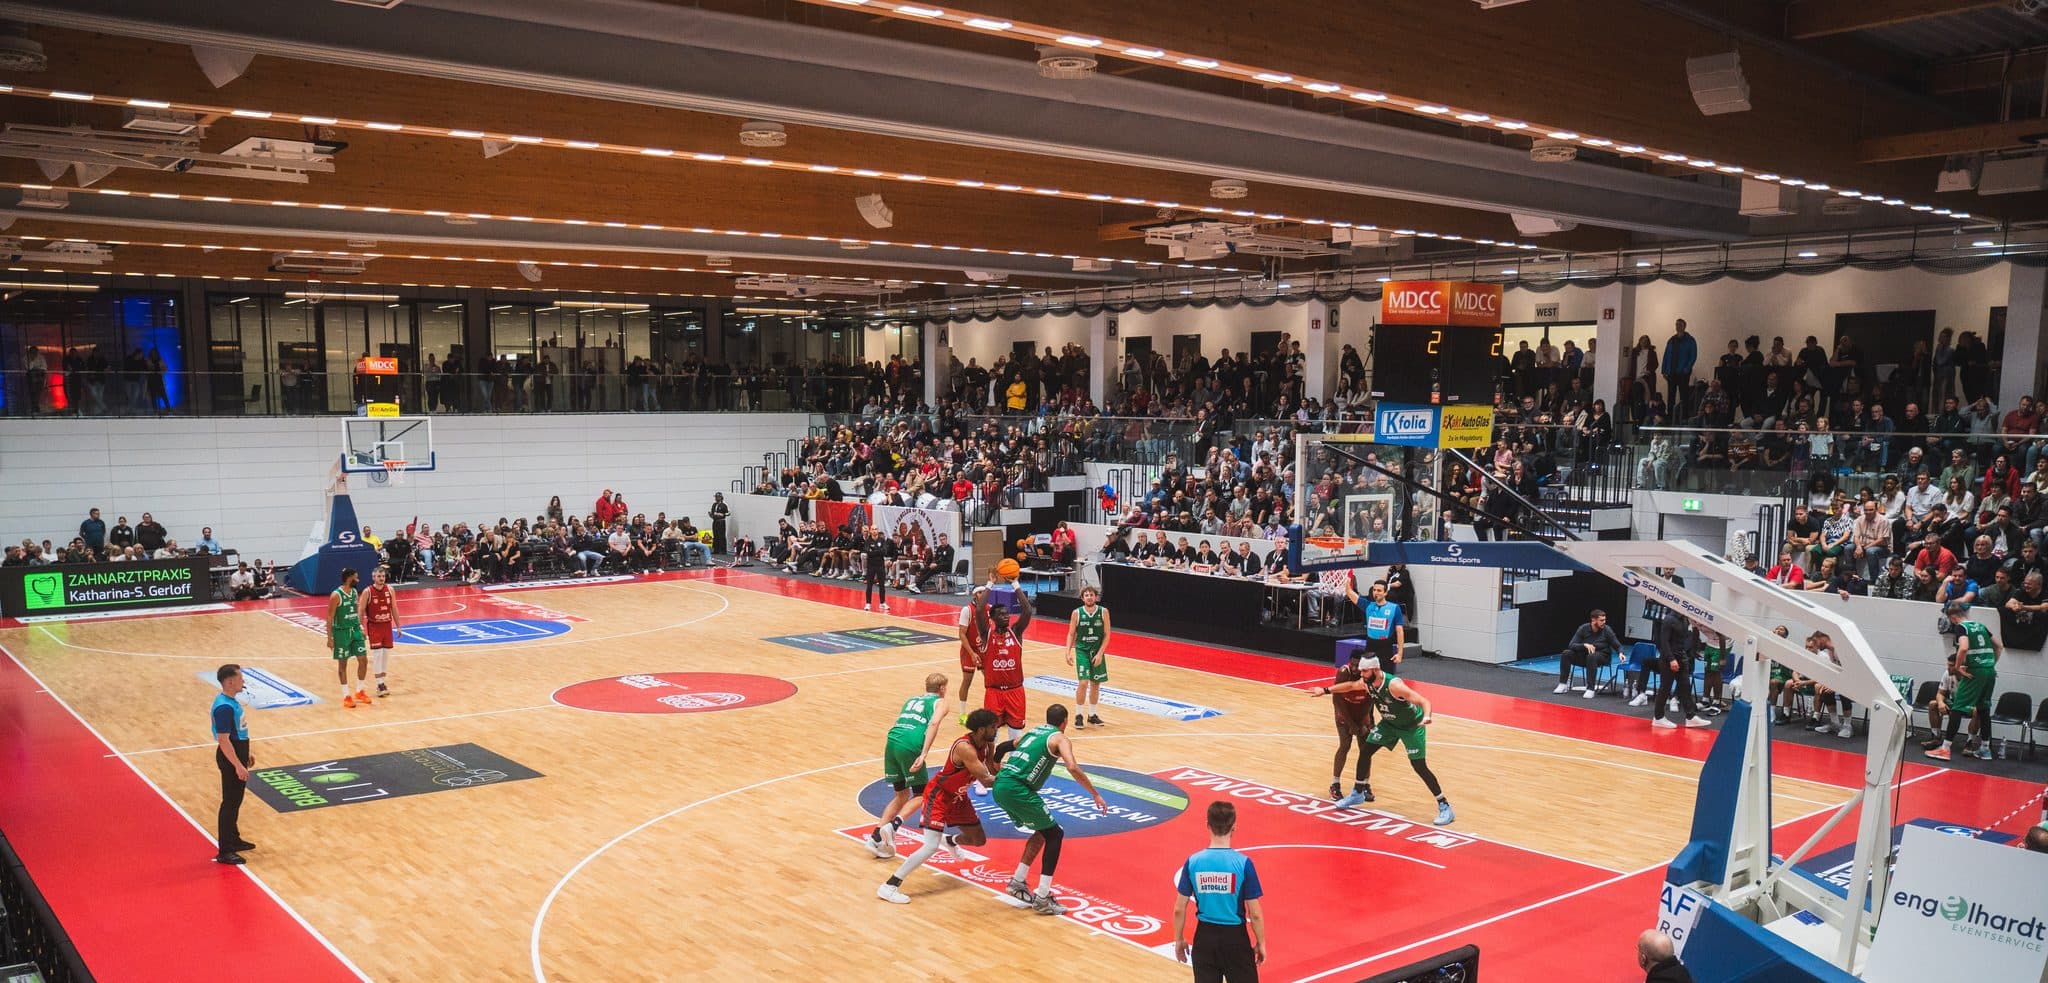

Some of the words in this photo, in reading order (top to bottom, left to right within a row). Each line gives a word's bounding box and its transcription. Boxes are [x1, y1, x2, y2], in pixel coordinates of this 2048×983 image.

[1389, 291, 1441, 309] MDCC
[1454, 292, 1496, 311] MDCC
[1330, 309, 1338, 328] C
[1536, 308, 1557, 317] WEST
[939, 329, 947, 344] A
[1108, 320, 1117, 337] B
[1427, 331, 1441, 354] 2
[1491, 333, 1502, 356] 2
[369, 361, 394, 369] MDCC
[1431, 555, 1457, 563] Schelde
[1458, 556, 1480, 564] Sports
[68, 568, 192, 587] ZAHNARZTPRAXIS
[69, 586, 146, 602] Katharina-S.
[149, 583, 191, 596] Gerloff
[1642, 580, 1680, 604] Schelde
[1682, 597, 1714, 622] Sports
[1977, 634, 1985, 646] 9
[256, 770, 328, 806] BARMER
[1170, 769, 1414, 835] WERSOMA
[1200, 875, 1227, 885] junited
[1952, 924, 2042, 952] EVENTSERVICE
